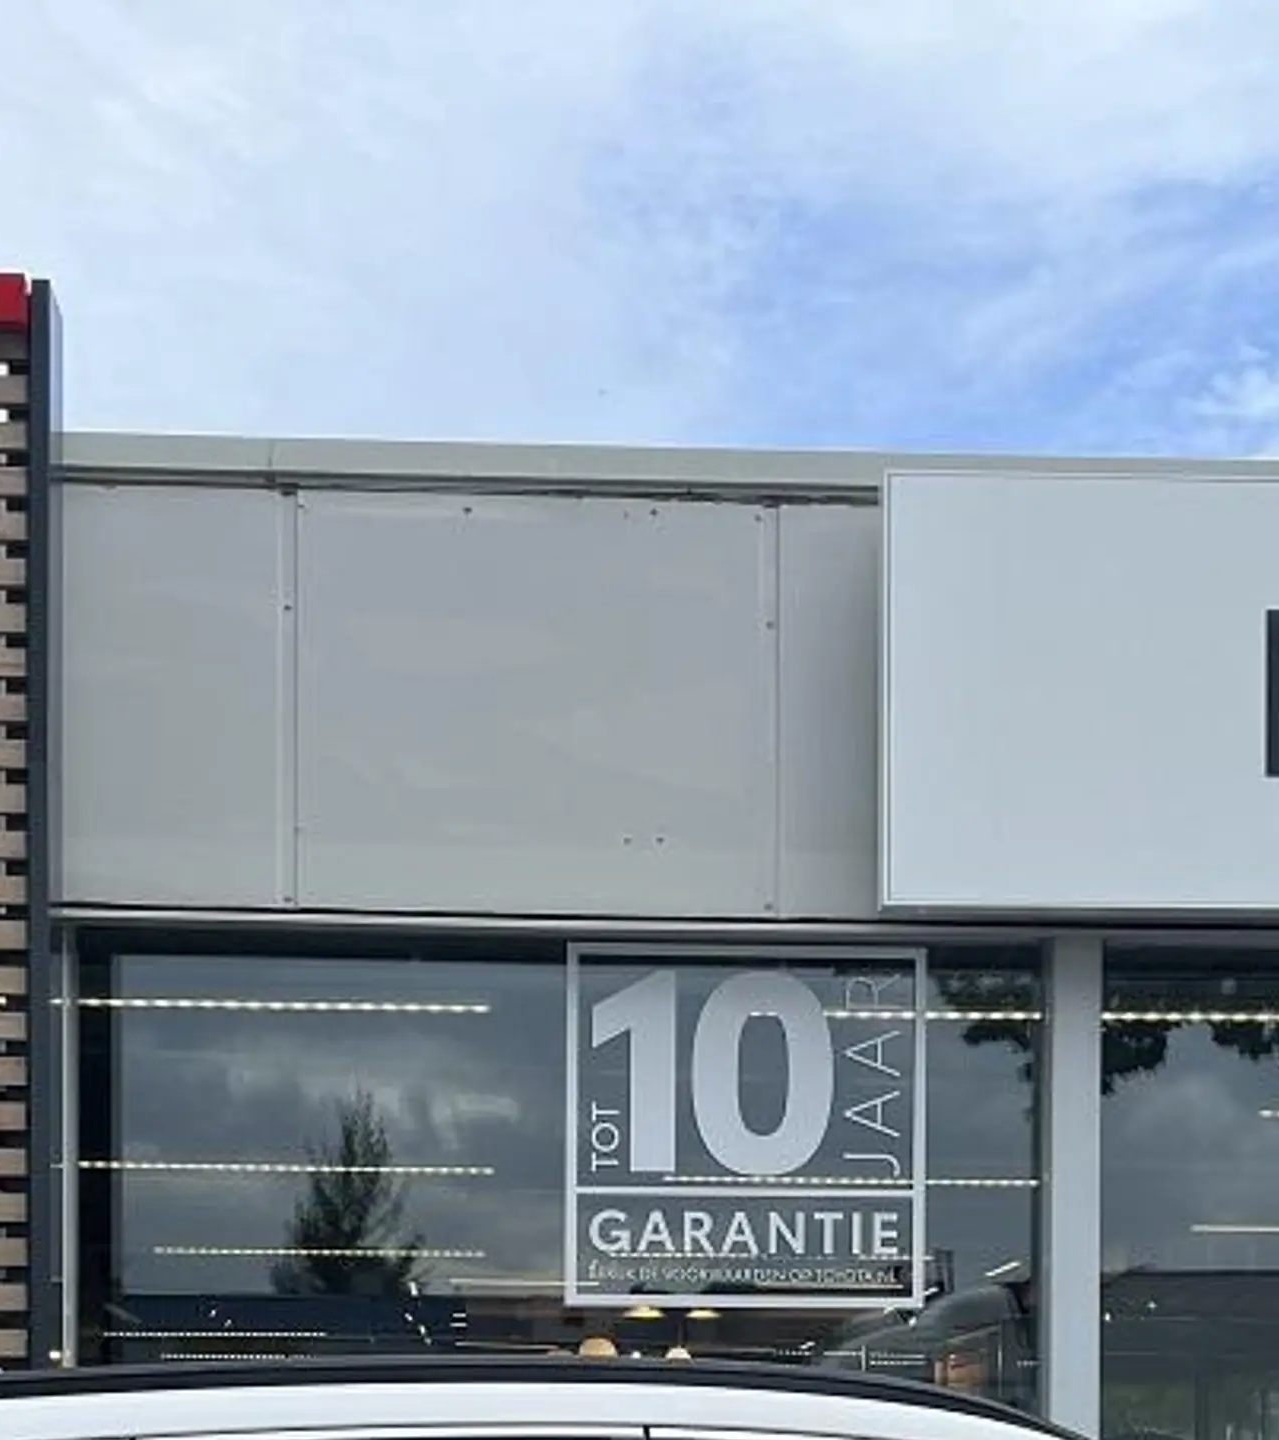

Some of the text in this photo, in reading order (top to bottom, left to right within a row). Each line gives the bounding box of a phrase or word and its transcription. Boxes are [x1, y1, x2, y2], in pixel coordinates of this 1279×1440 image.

[590, 968, 835, 1176] 10
[591, 1101, 620, 1172] TOT
[843, 972, 902, 1178] JAAR
[587, 1209, 900, 1257] GARANTIE
